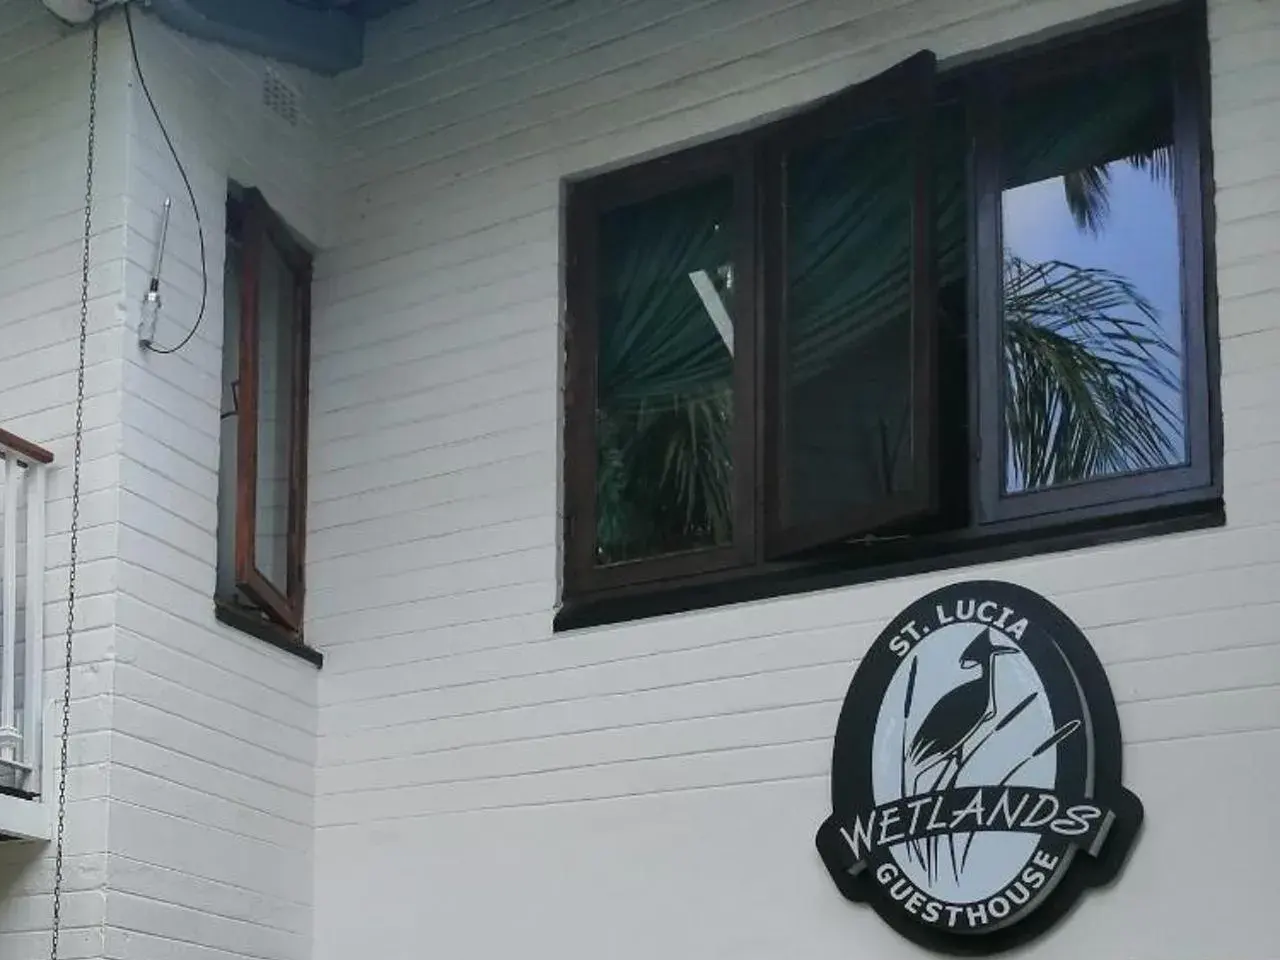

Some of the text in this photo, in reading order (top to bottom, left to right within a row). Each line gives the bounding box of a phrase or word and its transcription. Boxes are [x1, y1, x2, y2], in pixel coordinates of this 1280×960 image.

[888, 598, 1029, 658] ST. LUCIA
[840, 788, 1102, 860] WETLANDS
[876, 849, 1060, 928] GUESTHOUSE
